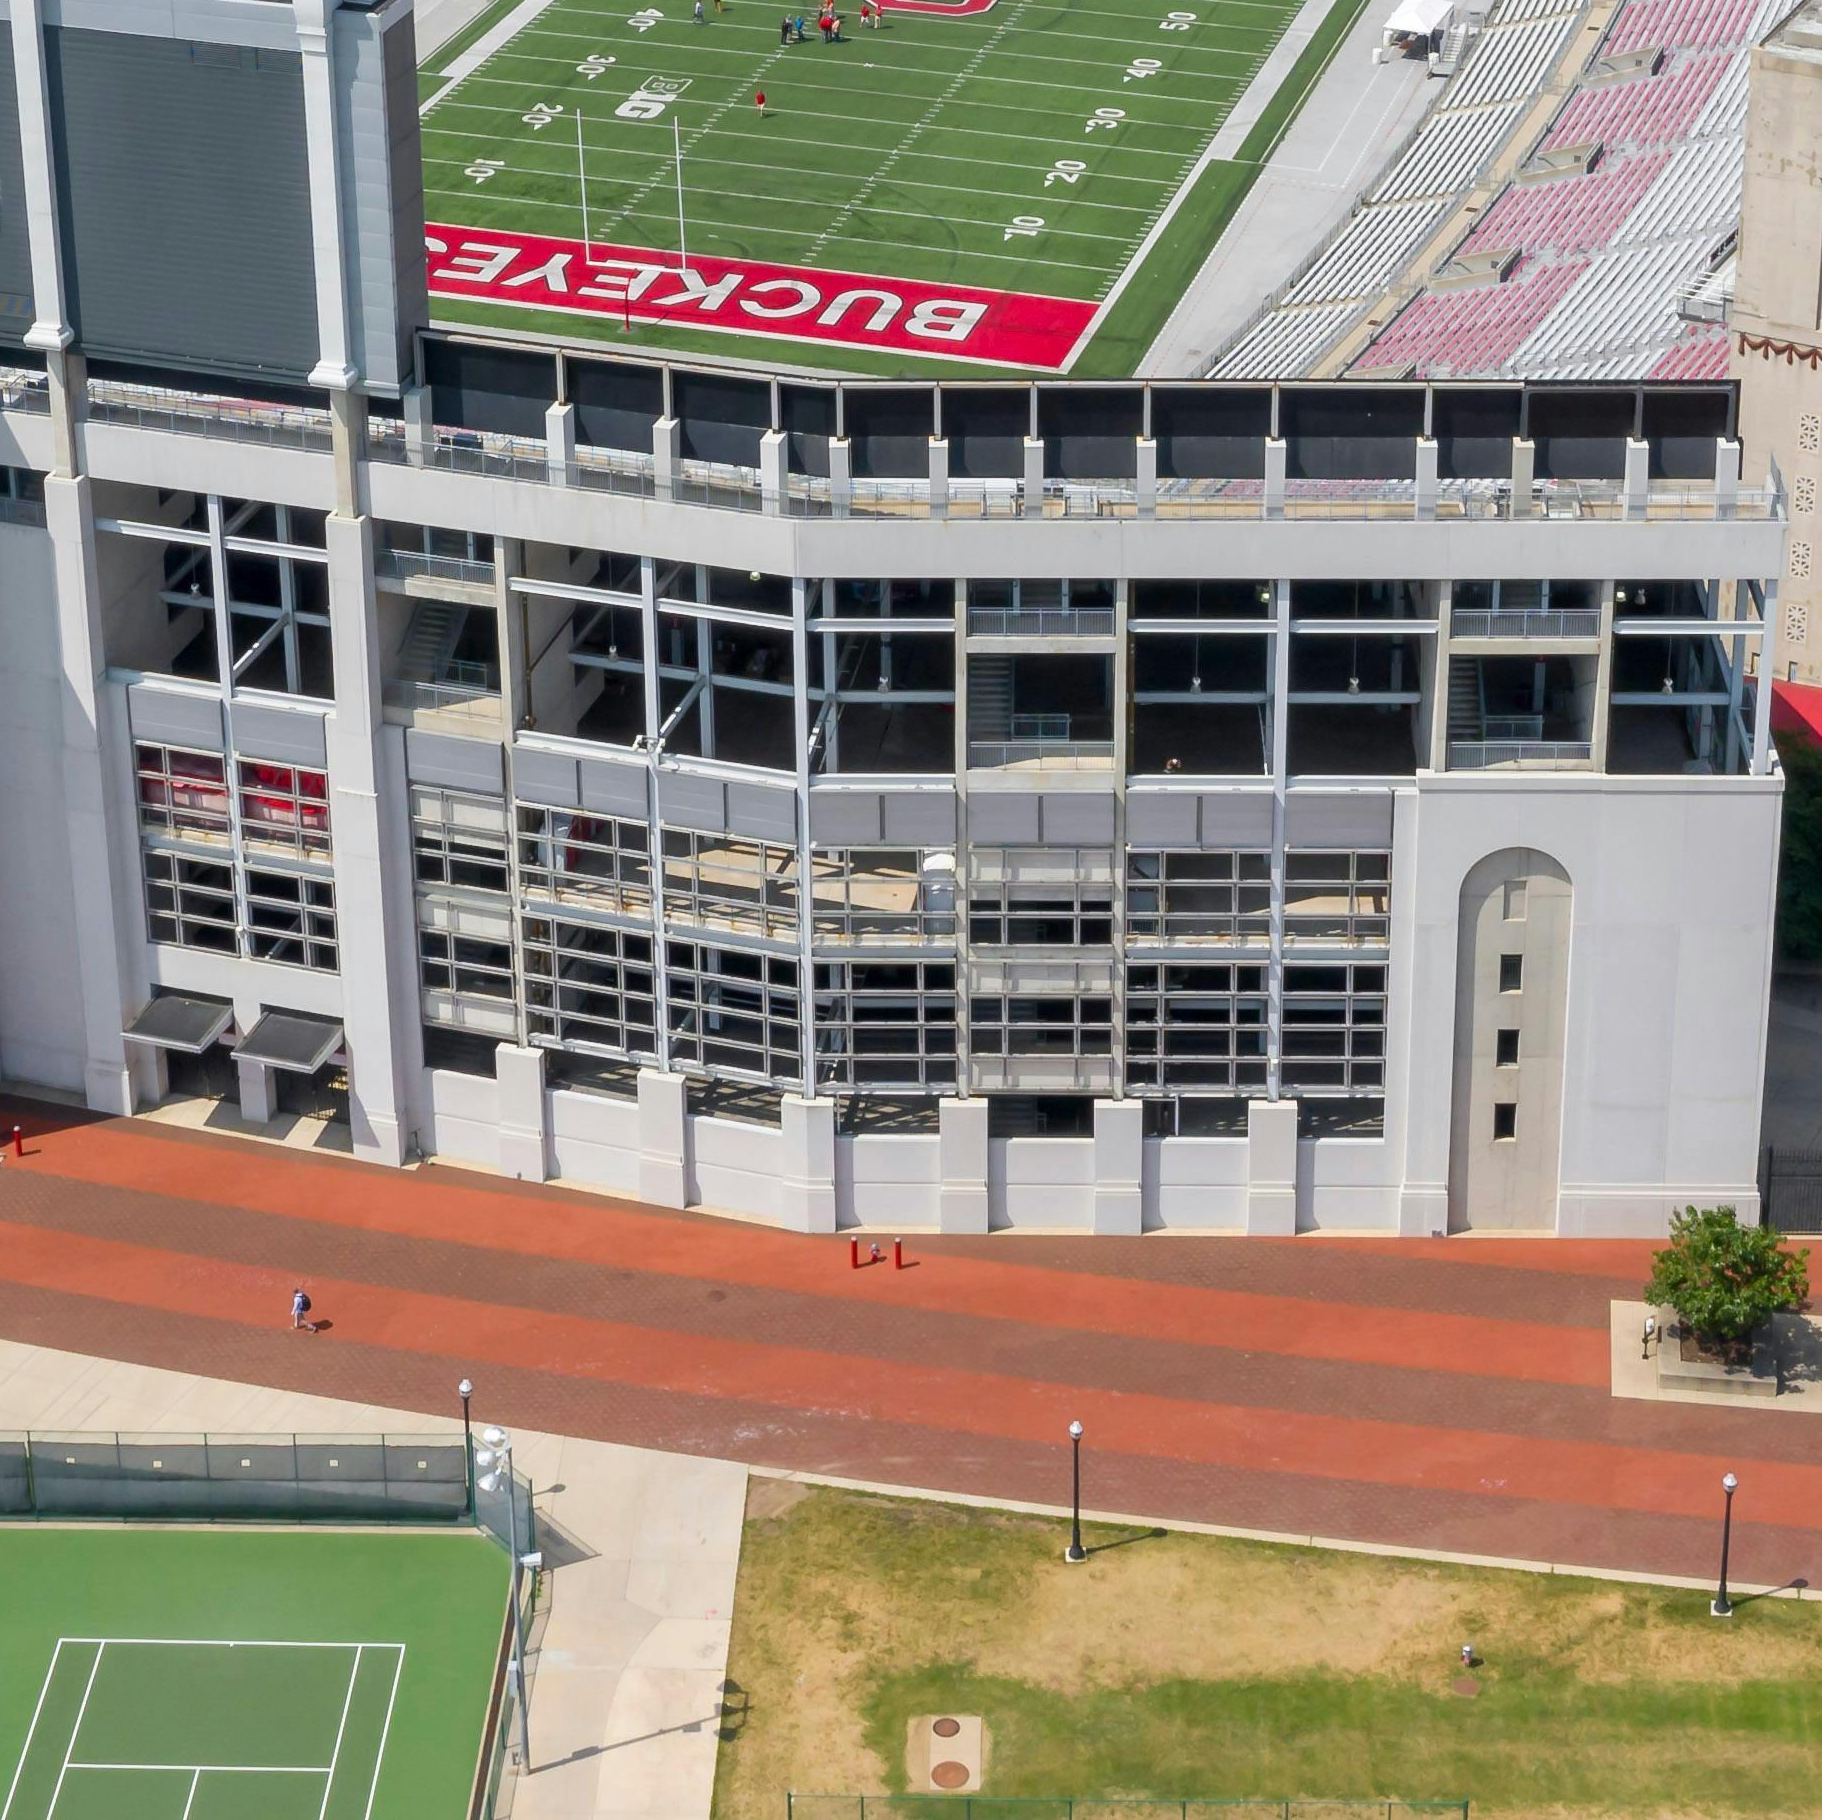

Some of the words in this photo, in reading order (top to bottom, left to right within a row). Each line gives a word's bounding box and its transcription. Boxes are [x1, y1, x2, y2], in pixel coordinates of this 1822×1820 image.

[627, 8, 665, 27] 40
[1158, 11, 1197, 30] 50
[576, 54, 617, 74] 30
[1126, 58, 1163, 78] 40
[521, 102, 563, 124] 20
[1086, 107, 1126, 129] 30
[463, 158, 505, 177] 10
[1045, 159, 1087, 184] 20
[1004, 215, 1045, 236] 10
